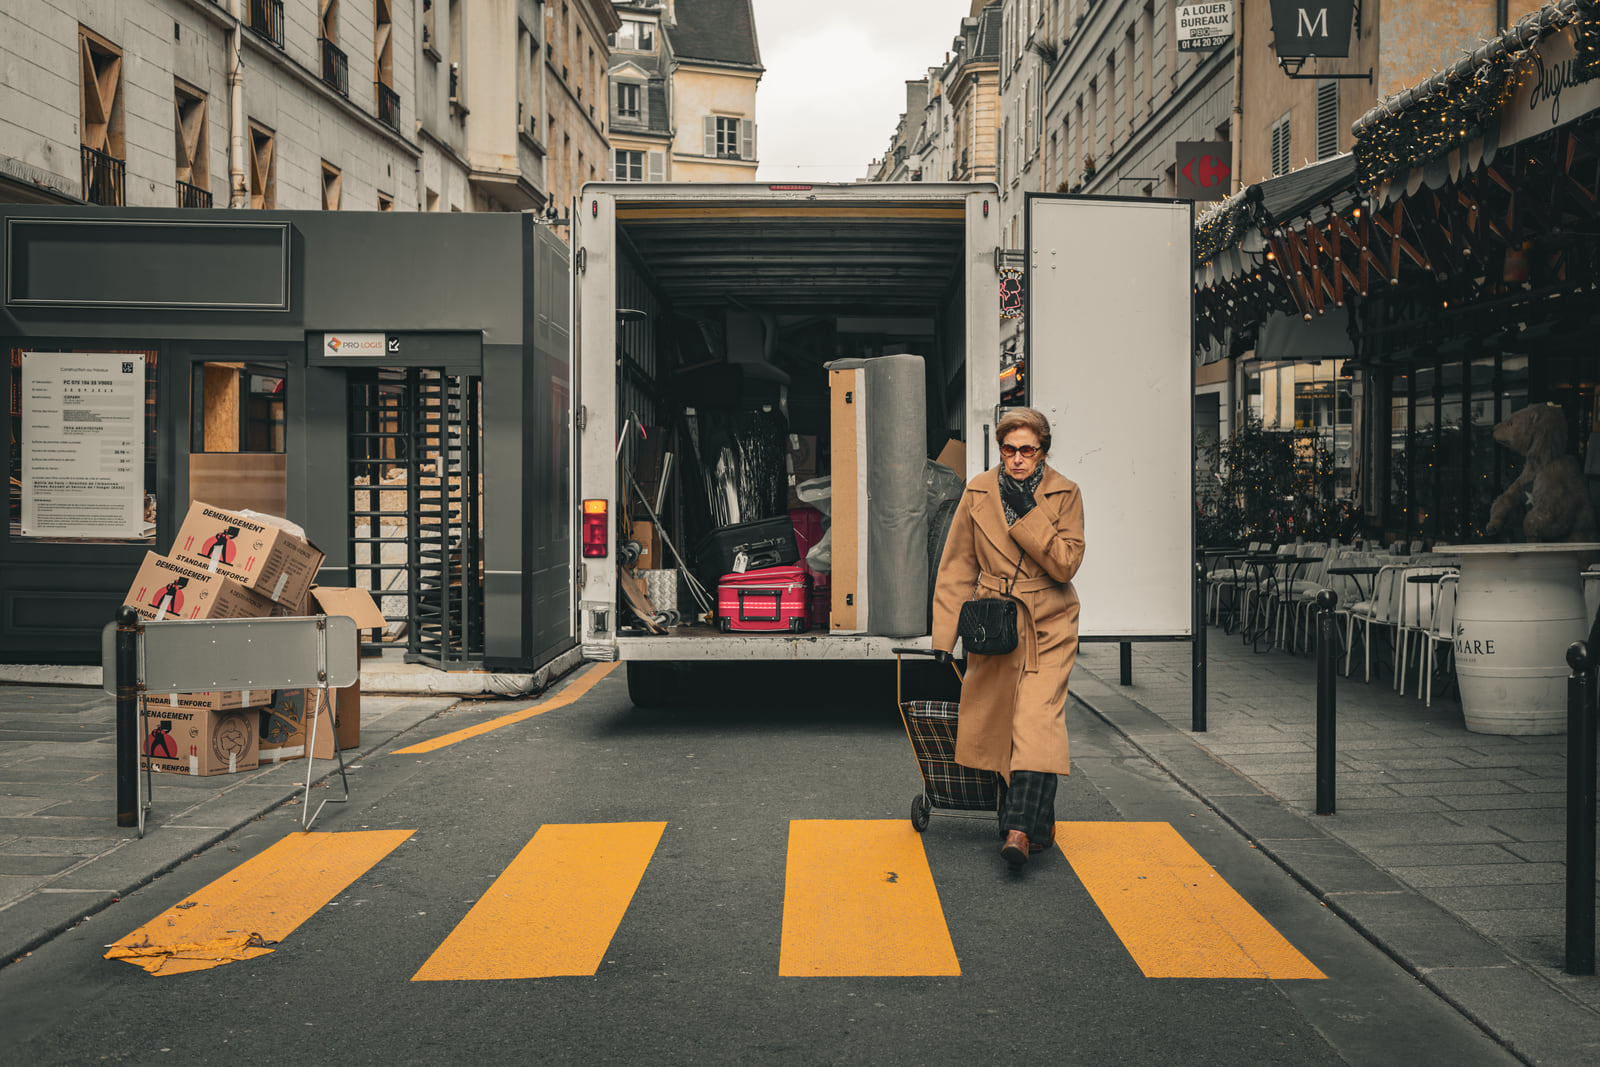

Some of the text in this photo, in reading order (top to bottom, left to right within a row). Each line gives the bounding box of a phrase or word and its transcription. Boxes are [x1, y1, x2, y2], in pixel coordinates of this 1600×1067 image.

[1183, 4, 1226, 16] A LOUER
[1181, 15, 1228, 28] BUREAUX
[1297, 8, 1328, 37] M
[1182, 41, 1190, 49] 01
[1192, 39, 1201, 48] 44
[1202, 38, 1211, 47] 20
[202, 508, 265, 533] DEMENAGEMENT
[155, 559, 211, 583] DEMENAGEMENT
[176, 554, 249, 584] STANDAR ENFORCE
[1456, 640, 1495, 655] MARE
[162, 763, 191, 773] RENFOR
